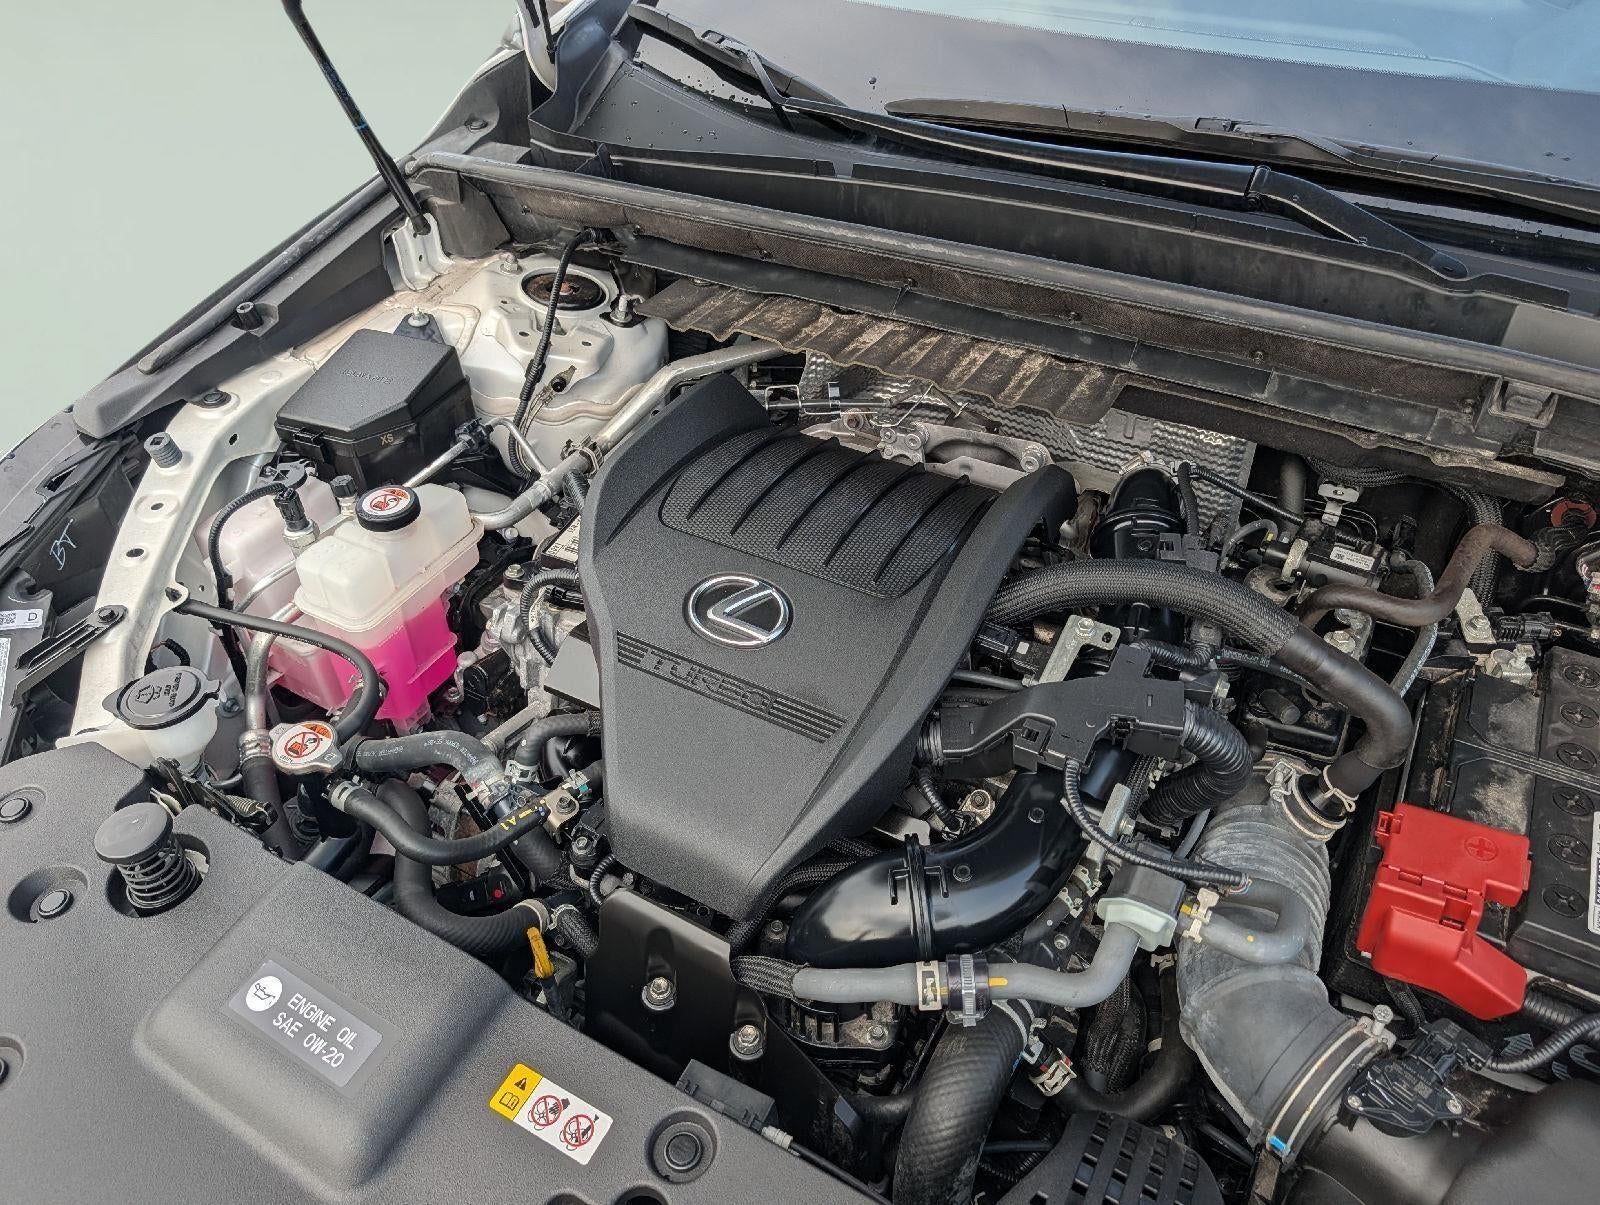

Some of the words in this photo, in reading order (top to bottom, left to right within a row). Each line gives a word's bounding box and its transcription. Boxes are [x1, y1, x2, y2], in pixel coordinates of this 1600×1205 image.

[28, 612, 38, 621] D
[650, 650, 772, 715] TURBO
[272, 1012, 304, 1038] SAE
[303, 1032, 345, 1068] 0W-20
[287, 992, 337, 1032] ENGINE
[336, 1026, 358, 1051] OIL
